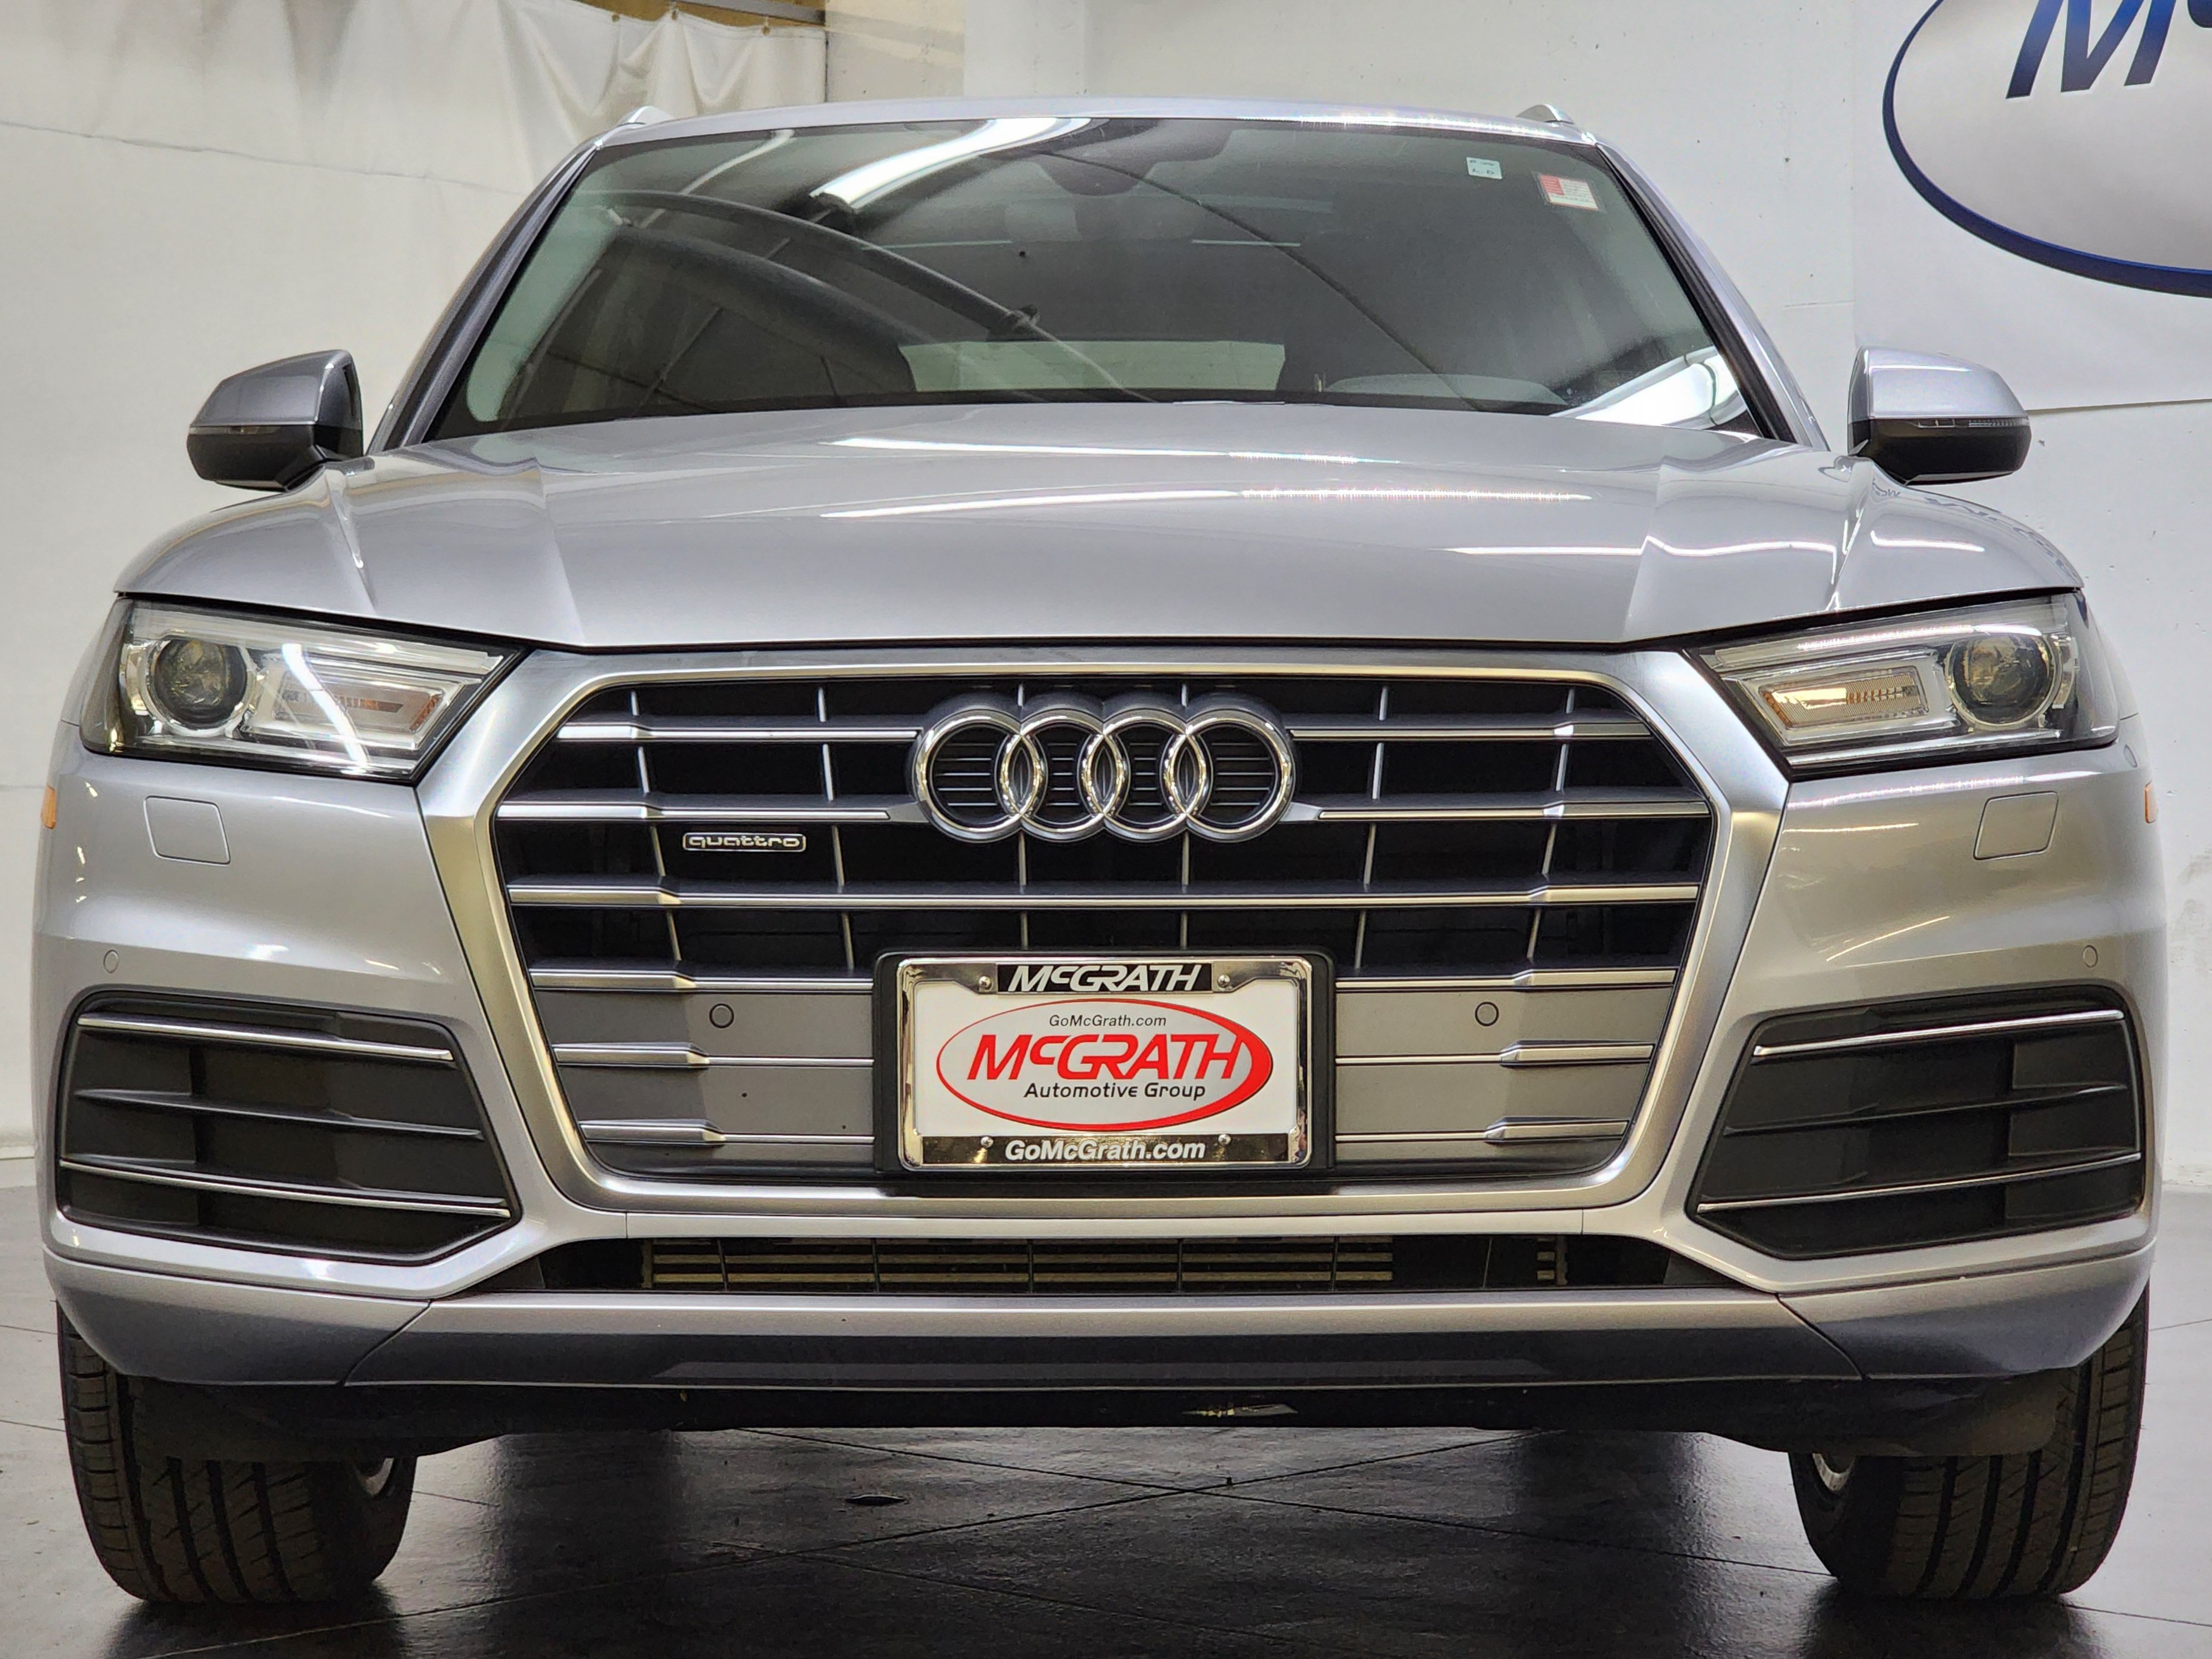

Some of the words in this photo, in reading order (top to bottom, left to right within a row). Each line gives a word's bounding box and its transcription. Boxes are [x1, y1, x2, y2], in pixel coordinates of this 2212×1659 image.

[689, 835, 800, 848] quattro
[1049, 1014, 1167, 1027] GoMcGrath.com
[1024, 1082, 1138, 1098] Automotive
[1144, 1082, 1206, 1101] Group
[1005, 1139, 1205, 1161] GoMcGrath.com
